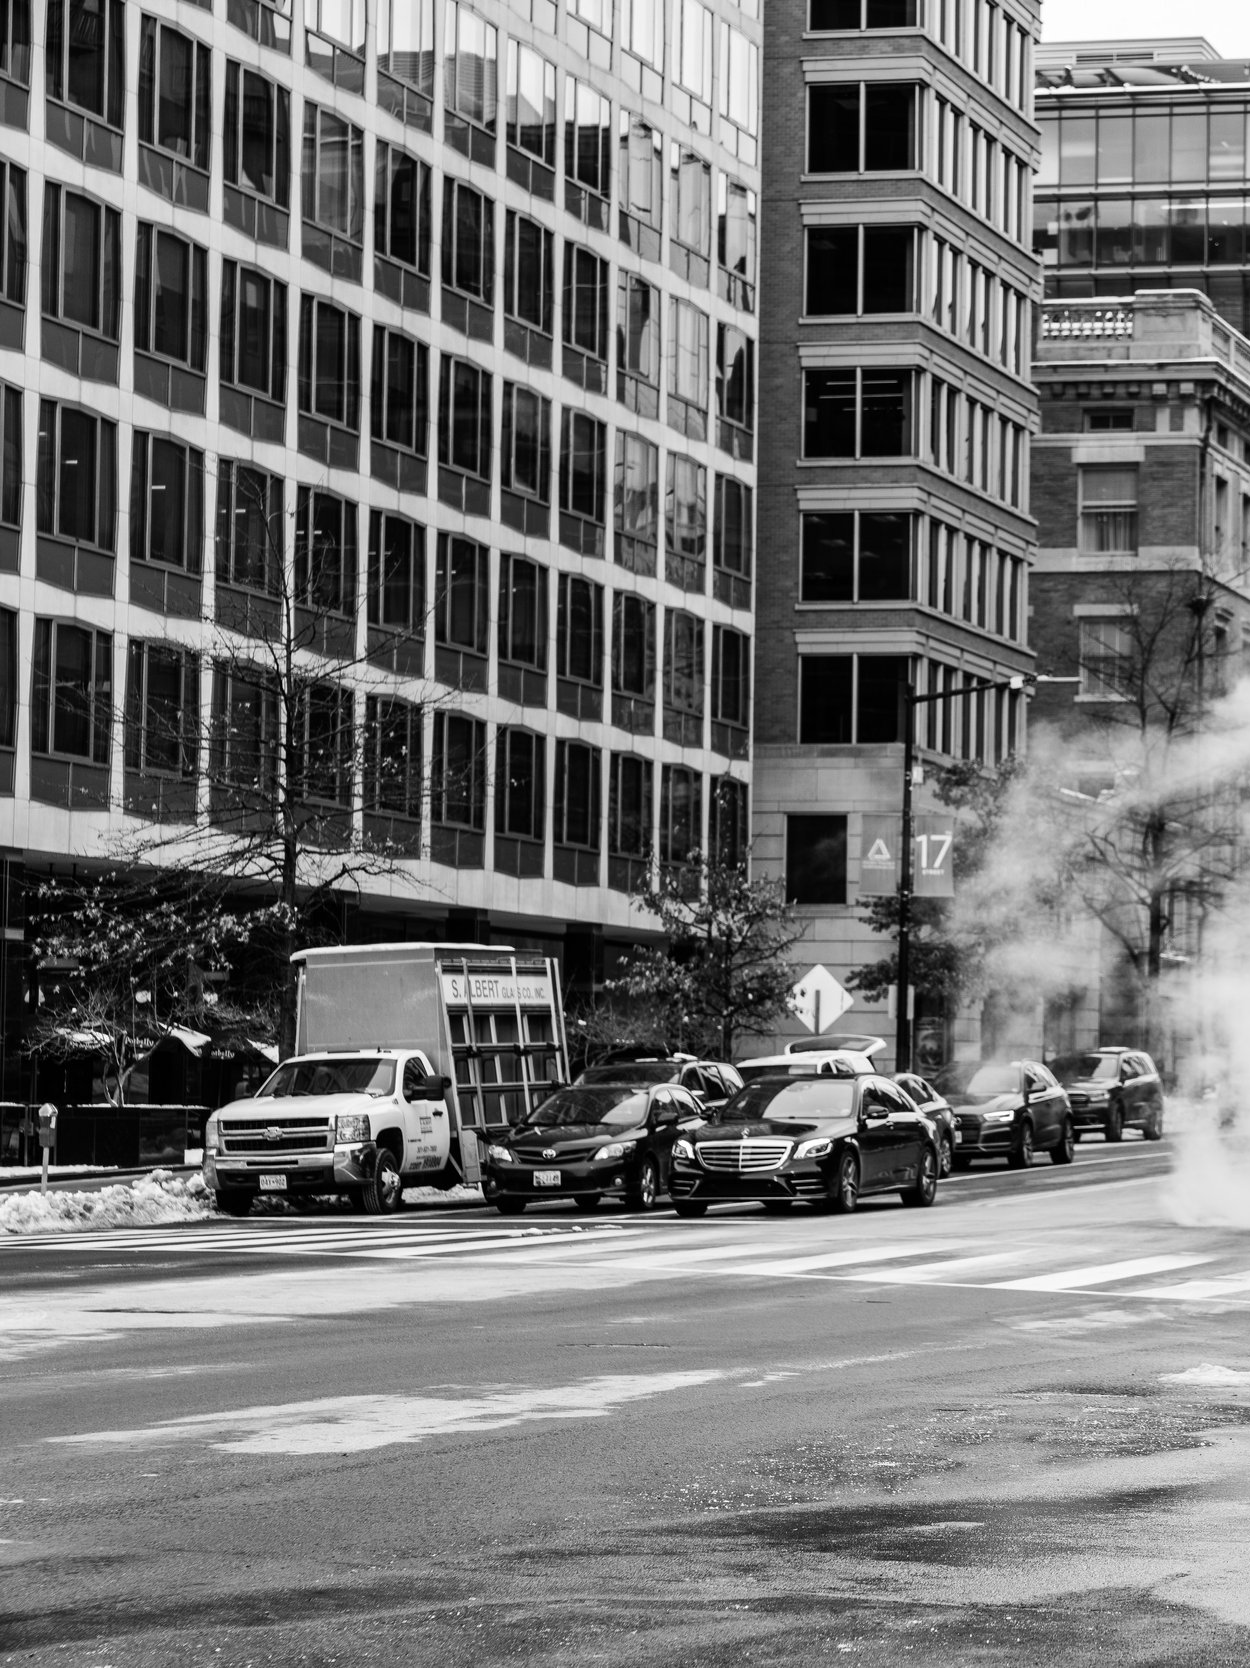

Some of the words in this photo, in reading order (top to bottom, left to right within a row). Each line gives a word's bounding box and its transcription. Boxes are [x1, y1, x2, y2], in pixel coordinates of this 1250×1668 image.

[915, 834, 953, 869] 17
[451, 979, 462, 999] S.
[501, 986, 521, 998] GLAS
[211, 1048, 235, 1060] otbelly
